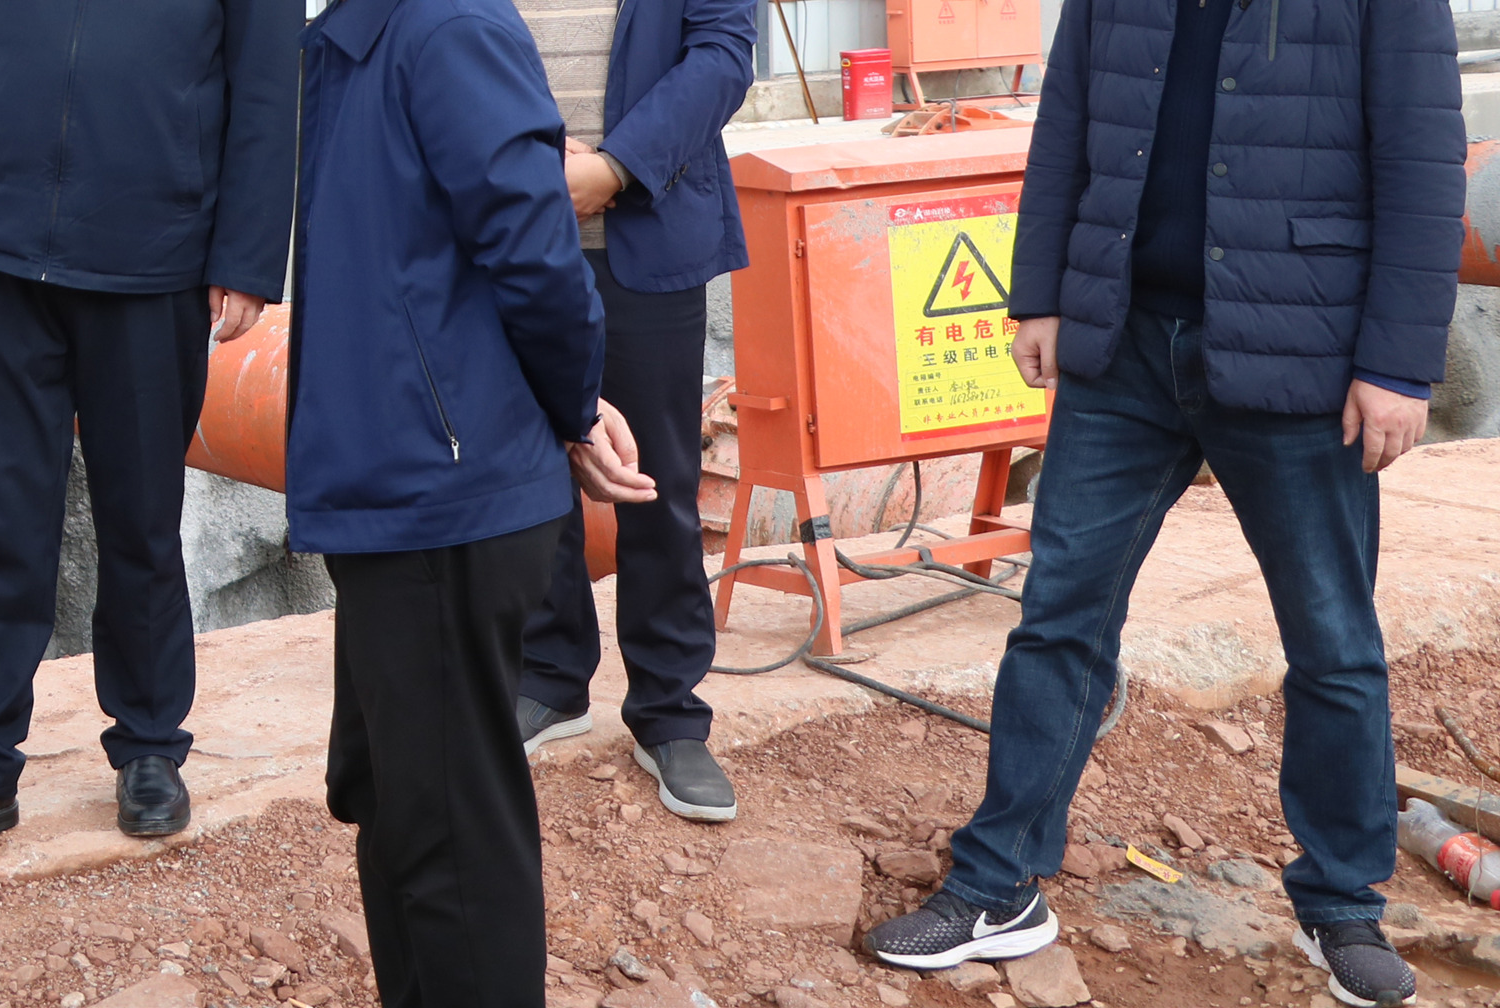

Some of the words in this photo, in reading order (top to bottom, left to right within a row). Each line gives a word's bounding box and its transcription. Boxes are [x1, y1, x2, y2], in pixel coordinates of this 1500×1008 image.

[914, 317, 1020, 347] 有电危险
[917, 386, 940, 395] 责任人
[913, 395, 944, 407] 联系电话
[923, 401, 1026, 425] 非专业人员严禁操作
